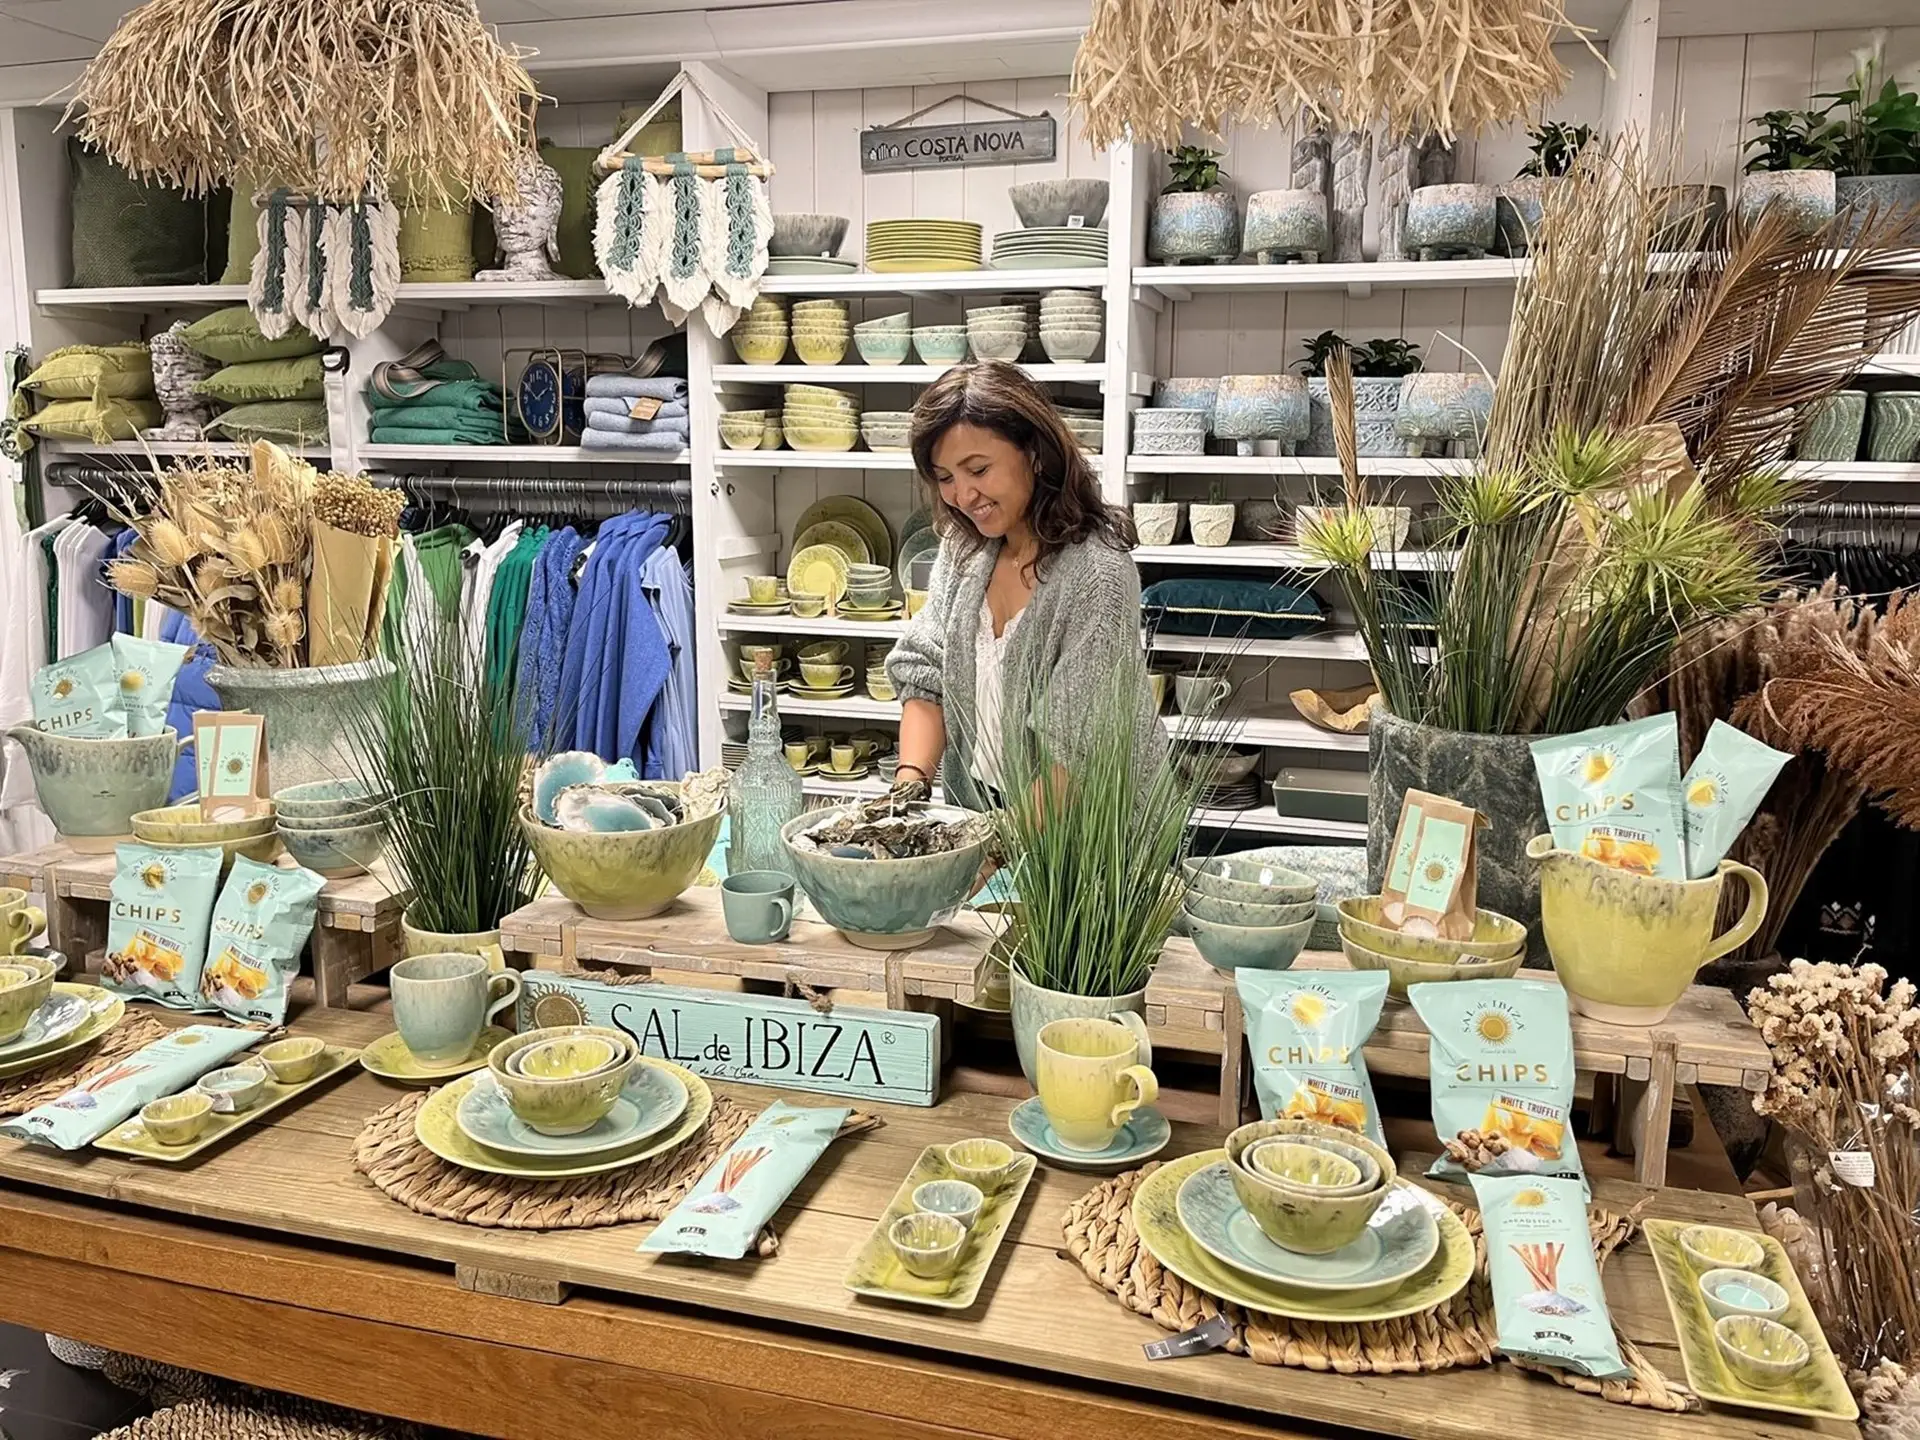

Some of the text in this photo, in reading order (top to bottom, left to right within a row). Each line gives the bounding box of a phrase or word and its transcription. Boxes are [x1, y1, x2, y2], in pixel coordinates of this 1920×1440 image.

[904, 131, 1025, 158] COSTA NOVA
[938, 154, 965, 163] PORTUGAL
[37, 708, 93, 733] CHIPS
[1555, 793, 1636, 822] CHIPS
[1614, 828, 1647, 842] TRUFFLE
[115, 902, 182, 924] CHIPS
[215, 917, 265, 941] CHIPS
[158, 937, 181, 951] TRUFFLE
[1463, 999, 1527, 1034] SAL de IBIZA
[611, 1002, 700, 1062] SAL
[703, 1033, 733, 1062] de
[1268, 1045, 1351, 1066] CHIPS
[1456, 1063, 1549, 1083] CHIPS
[1306, 1078, 1360, 1100] WHITE TRUFFLE
[1500, 1094, 1560, 1120] WHITE TRUFFLE
